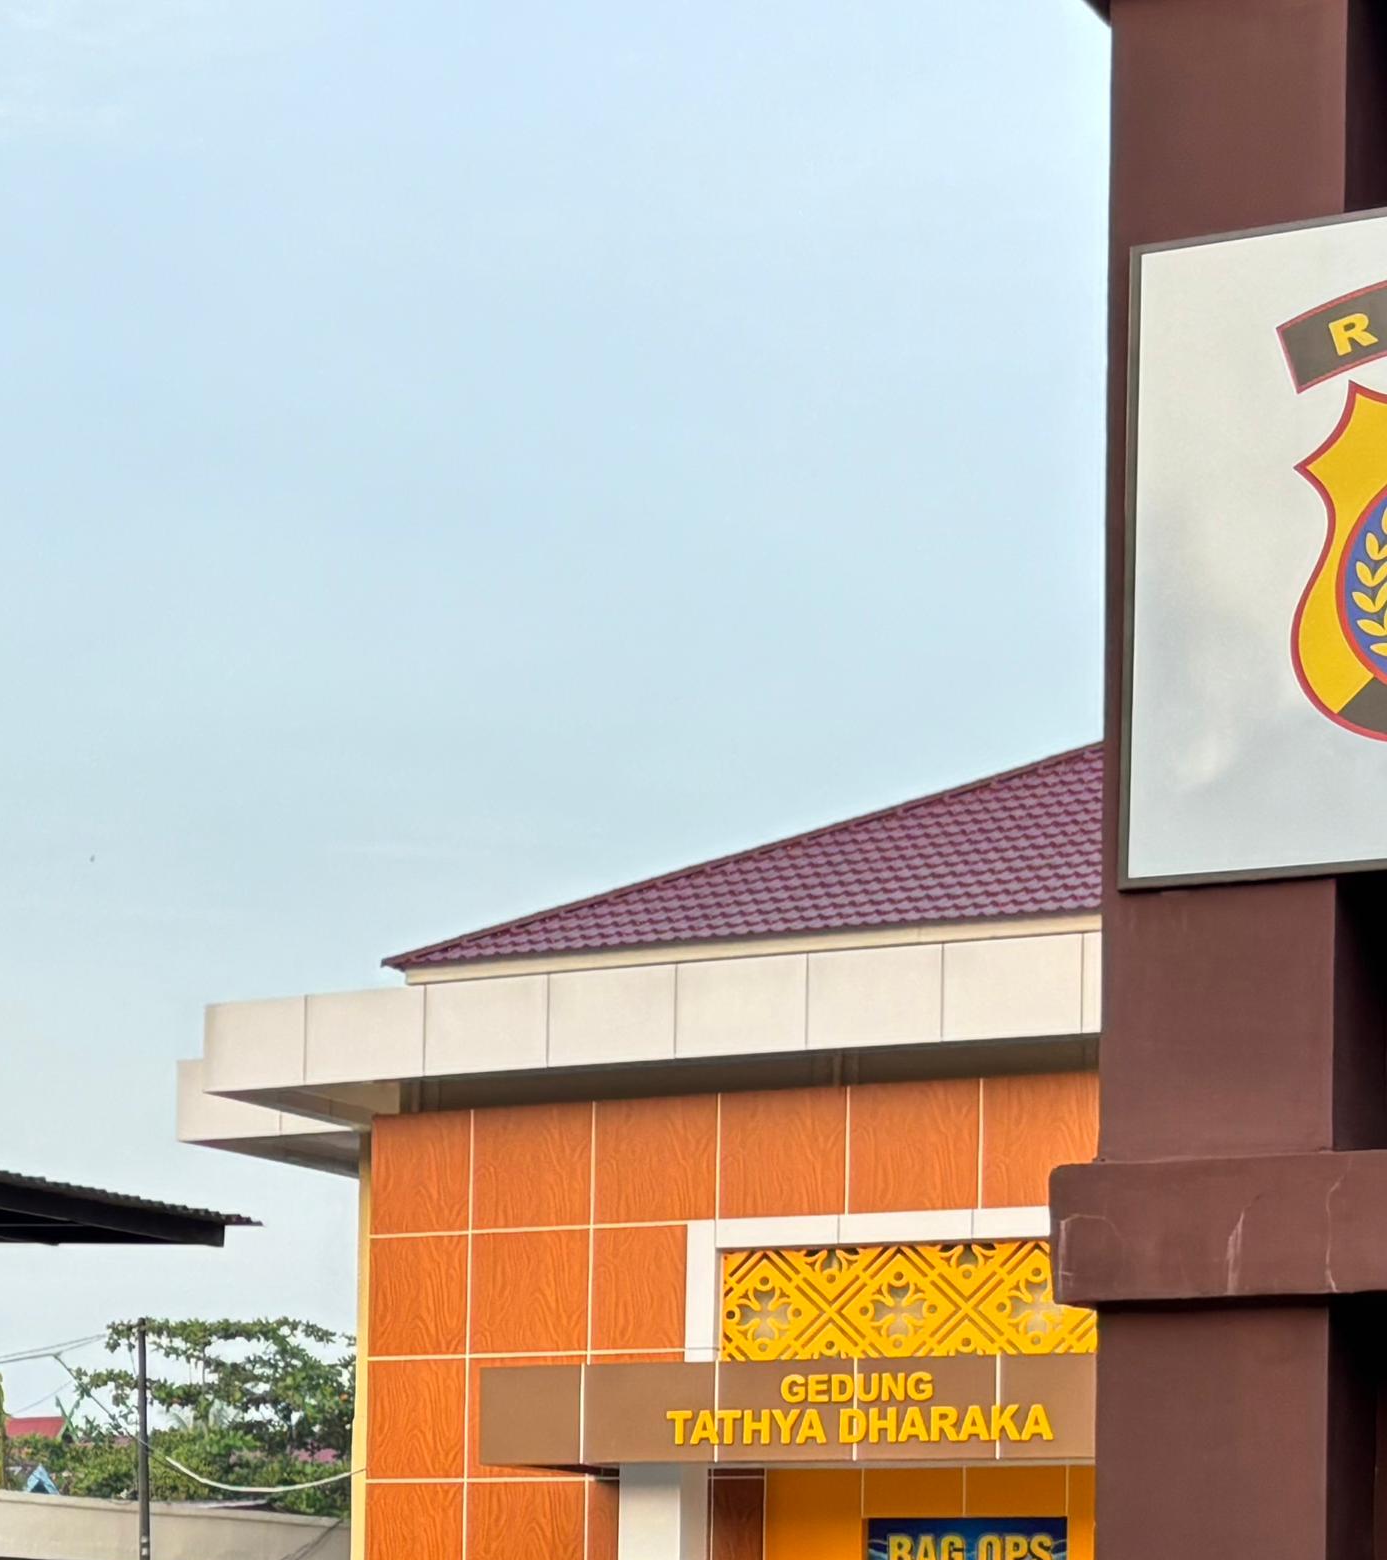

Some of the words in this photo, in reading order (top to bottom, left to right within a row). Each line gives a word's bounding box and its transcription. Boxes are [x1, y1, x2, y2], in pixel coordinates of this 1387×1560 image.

[780, 1372, 934, 1403] GEDUNG
[666, 1408, 827, 1446] TATHYA
[839, 1404, 1054, 1444] DHARAKA
